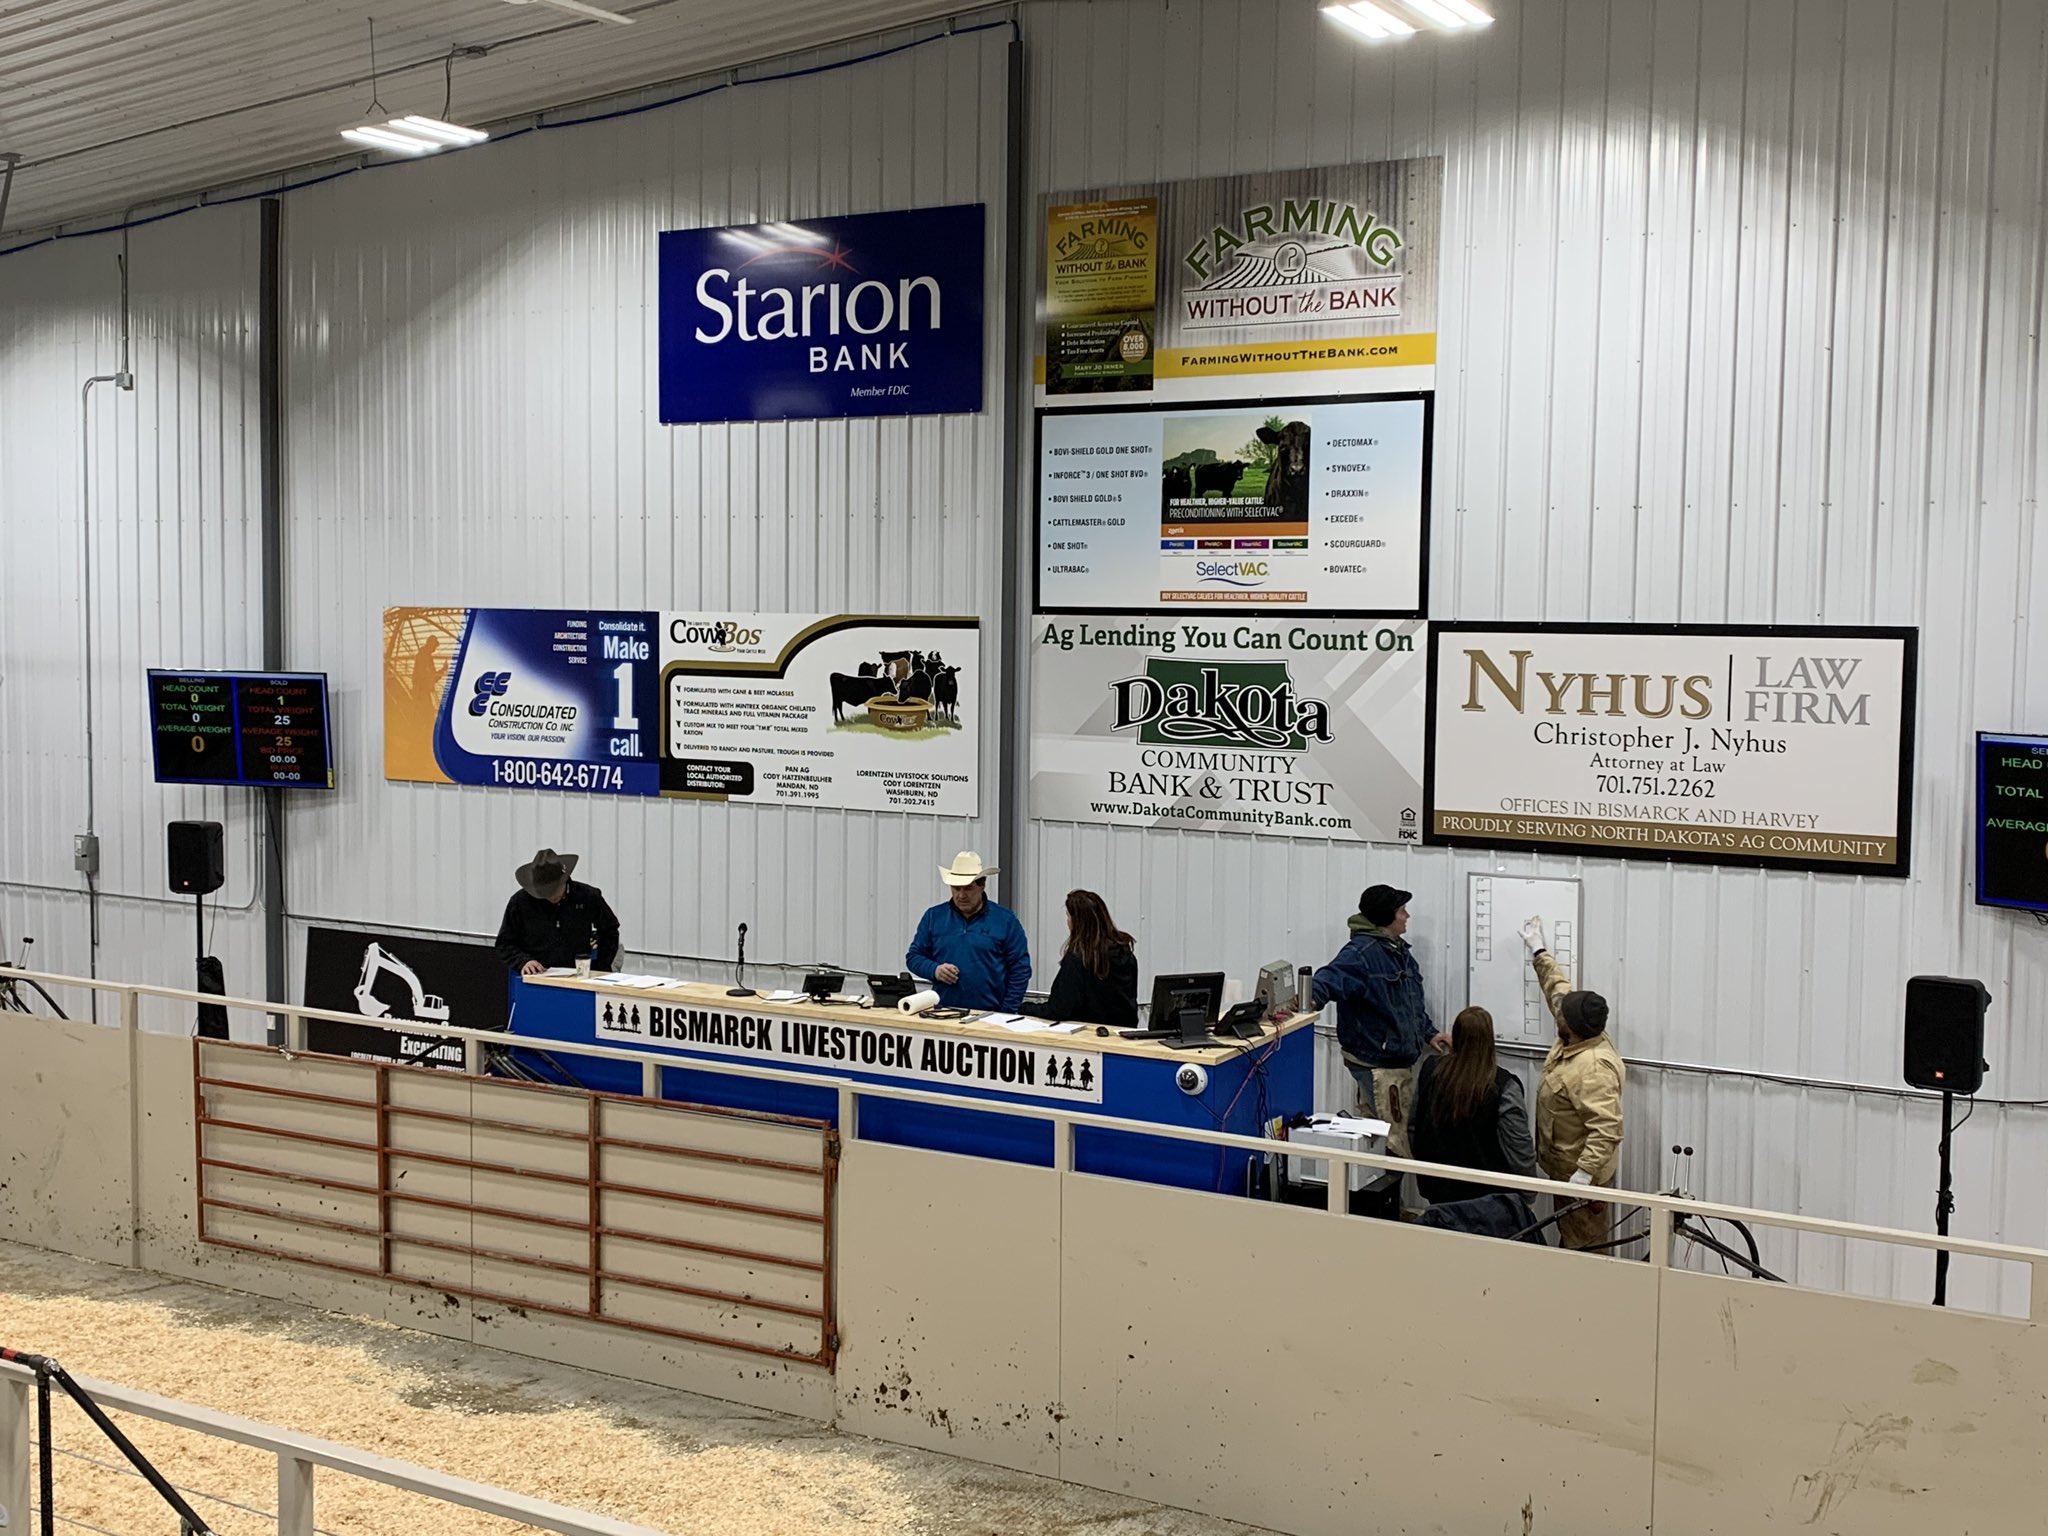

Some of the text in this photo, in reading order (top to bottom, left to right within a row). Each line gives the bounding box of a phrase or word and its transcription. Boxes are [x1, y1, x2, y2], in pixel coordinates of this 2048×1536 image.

[1056, 219, 1148, 256] FARMING
[1184, 199, 1402, 281] FARMING
[1057, 262, 1103, 274] WITHOUT
[1118, 258, 1147, 269] BANK
[695, 268, 941, 344] Starion
[1187, 286, 1397, 320] WITHOUT the BANK
[1123, 335, 1144, 343] OVER
[1123, 343, 1144, 351] 8,000
[809, 342, 910, 373] BANK
[850, 385, 911, 398] Member FDIC
[1116, 446, 1128, 454] ONE
[1111, 470, 1128, 478] SHOT
[1053, 495, 1068, 503] BOVI
[1169, 507, 1225, 518] PRECONDITIONING
[1227, 507, 1244, 517] WITH
[1107, 518, 1125, 526] GOLD
[1053, 542, 1065, 550] ONE
[1196, 561, 1268, 576] SelectVAC
[599, 621, 638, 631] Consolidate
[1042, 623, 1414, 653] Ag Lending You Can Count On
[553, 644, 587, 652] CONSTRUCTION
[604, 635, 649, 660] Make
[1755, 656, 1862, 690] LAW
[1461, 649, 1712, 720] NYHUS
[191, 693, 199, 703] 0
[277, 696, 284, 705] 1
[613, 663, 639, 730] 1
[190, 704, 225, 712] WEIGHT
[1108, 667, 1335, 748] Dakota
[1744, 690, 1871, 726] FIRM
[192, 713, 200, 722] 0
[274, 715, 290, 725] 25
[191, 735, 205, 752] 0
[275, 736, 292, 746] 25
[610, 734, 644, 758] call.
[1534, 721, 1787, 757] Christopher J. Nyhus
[270, 755, 296, 763] 00.00
[1141, 750, 1297, 774] COMMUNITY
[1590, 752, 1726, 774] Attorney at Law
[2001, 758, 2042, 769] HEAD
[492, 759, 624, 790] 1-800-642-6774
[687, 764, 713, 772] CONTACT
[857, 770, 969, 782] LORENTZEN LIVESTOCK SOLUTIONS
[903, 781, 941, 789] LORENTZEN
[1108, 771, 1334, 805] BANK & TRUST
[1596, 774, 1716, 798] 701.751.2262
[1995, 785, 2044, 799] TOTAL
[1090, 800, 1352, 830] www.DakotaCommunityBank.com
[1500, 797, 1820, 829] OFFICES IN BISMARCK AND HARVEY
[1398, 830, 1417, 840] FDIC
[1442, 816, 1887, 857] PROUDLY SERVING NORTH DAKOTA'S AG COMMUNITY
[649, 1006, 1036, 1086] BISMARCK LIVESTOCK AUCTION
